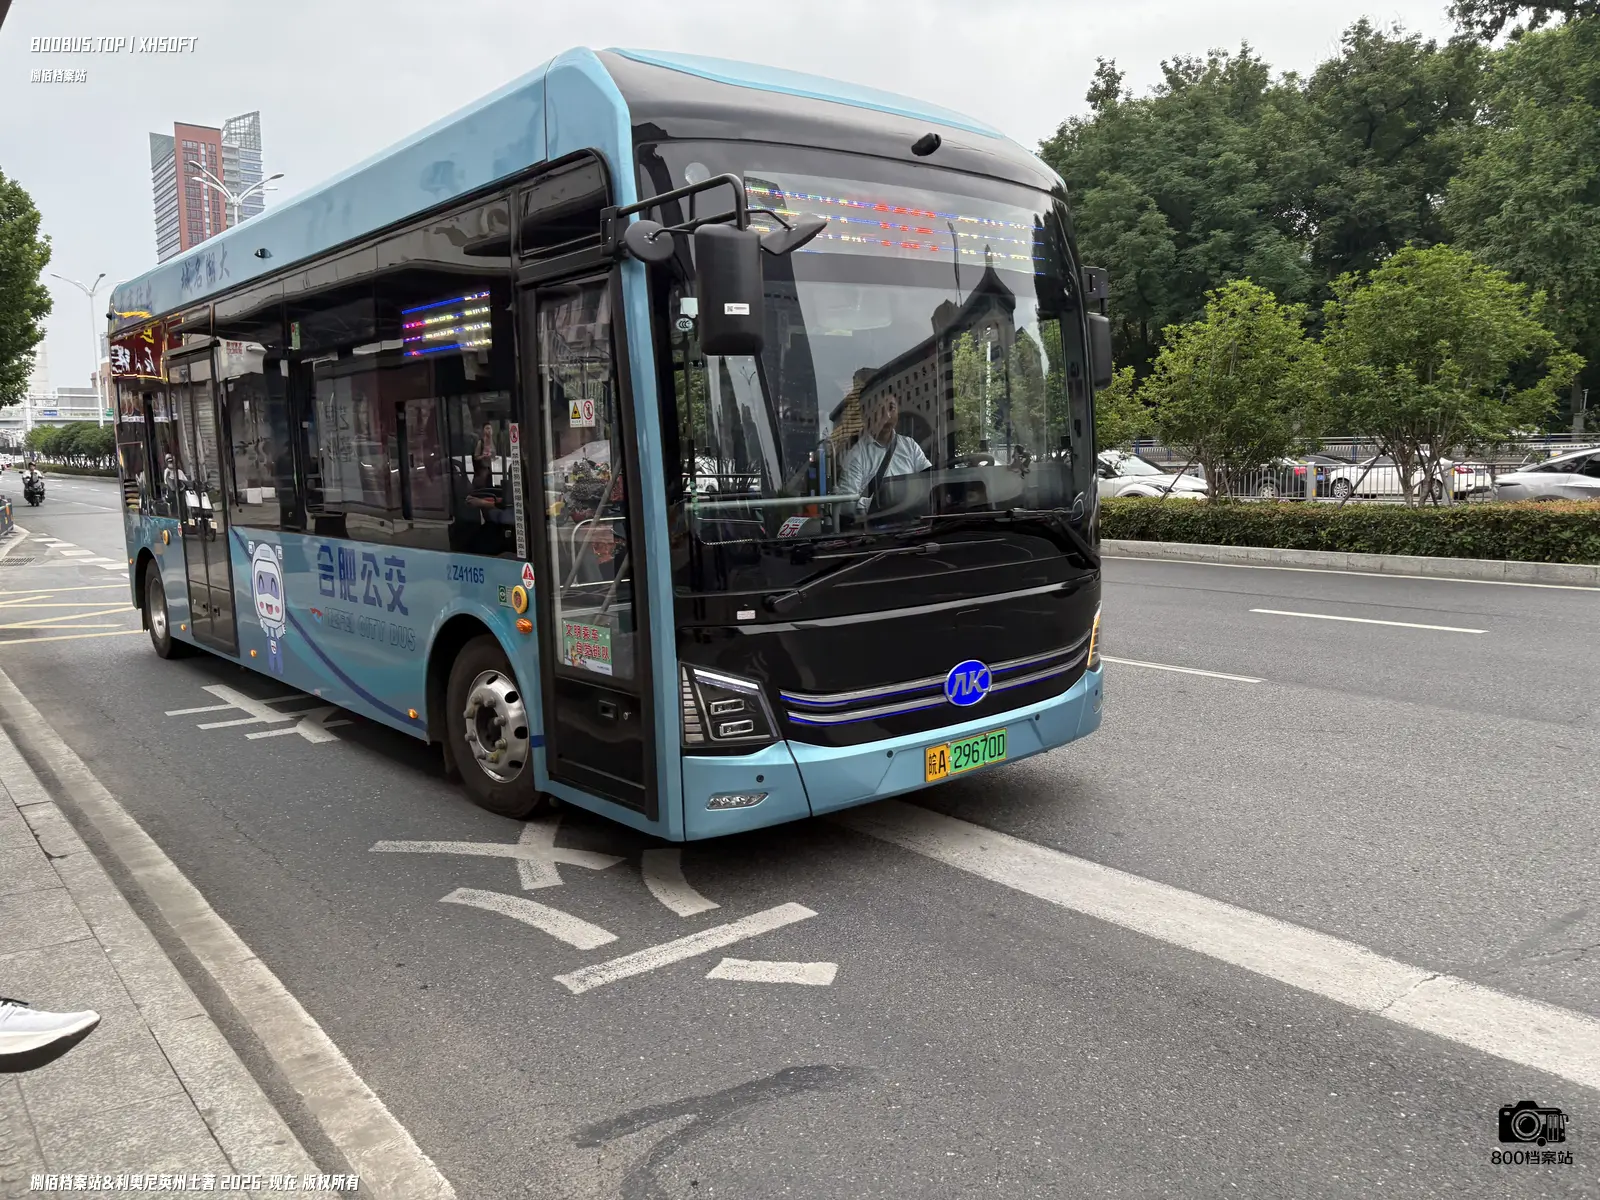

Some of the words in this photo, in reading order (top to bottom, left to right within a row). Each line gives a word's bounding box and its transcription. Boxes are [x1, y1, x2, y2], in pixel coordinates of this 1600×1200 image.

[317, 544, 409, 616] 合肥公交
[953, 733, 1005, 769] 29670D
